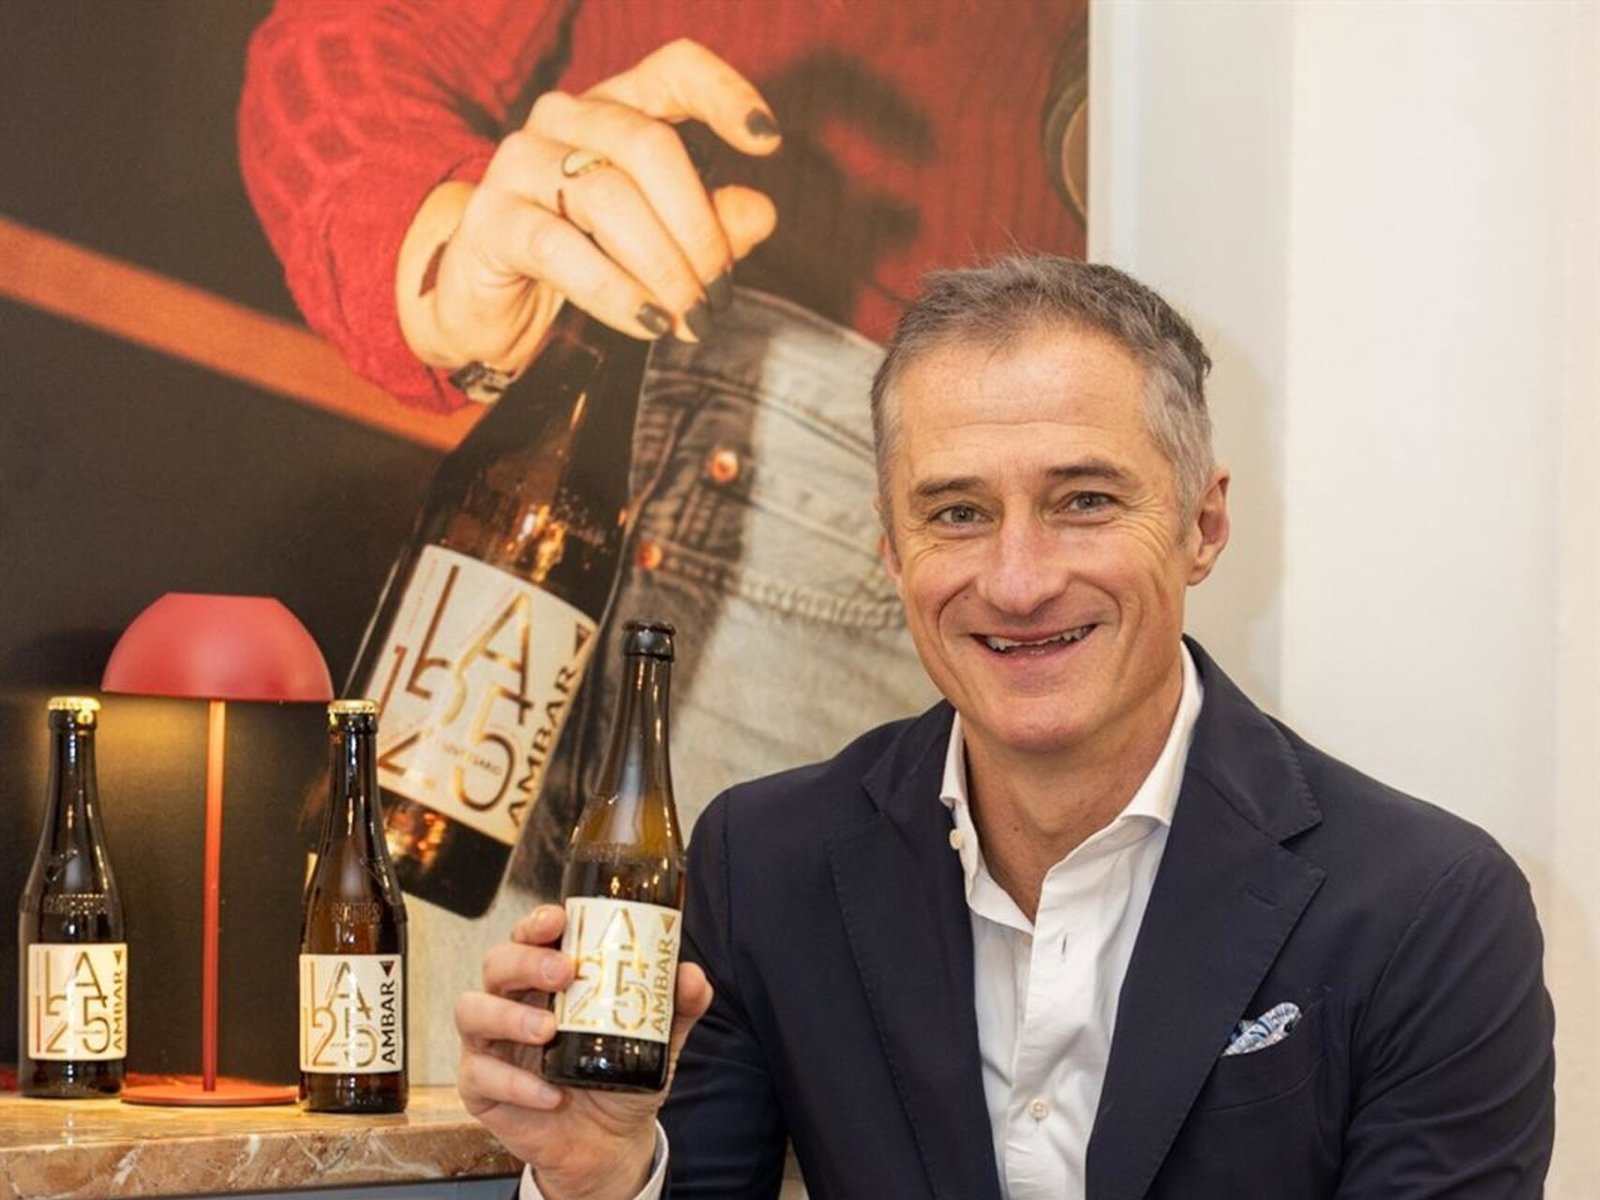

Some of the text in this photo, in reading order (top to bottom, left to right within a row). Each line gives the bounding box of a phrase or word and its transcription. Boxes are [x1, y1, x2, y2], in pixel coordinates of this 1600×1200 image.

[405, 564, 533, 725] LA
[508, 663, 577, 828] AMBAR
[45, 951, 108, 1016] LA
[311, 960, 372, 1027] LA
[380, 979, 396, 1065] AMBAR
[651, 937, 674, 1034] AMBAR
